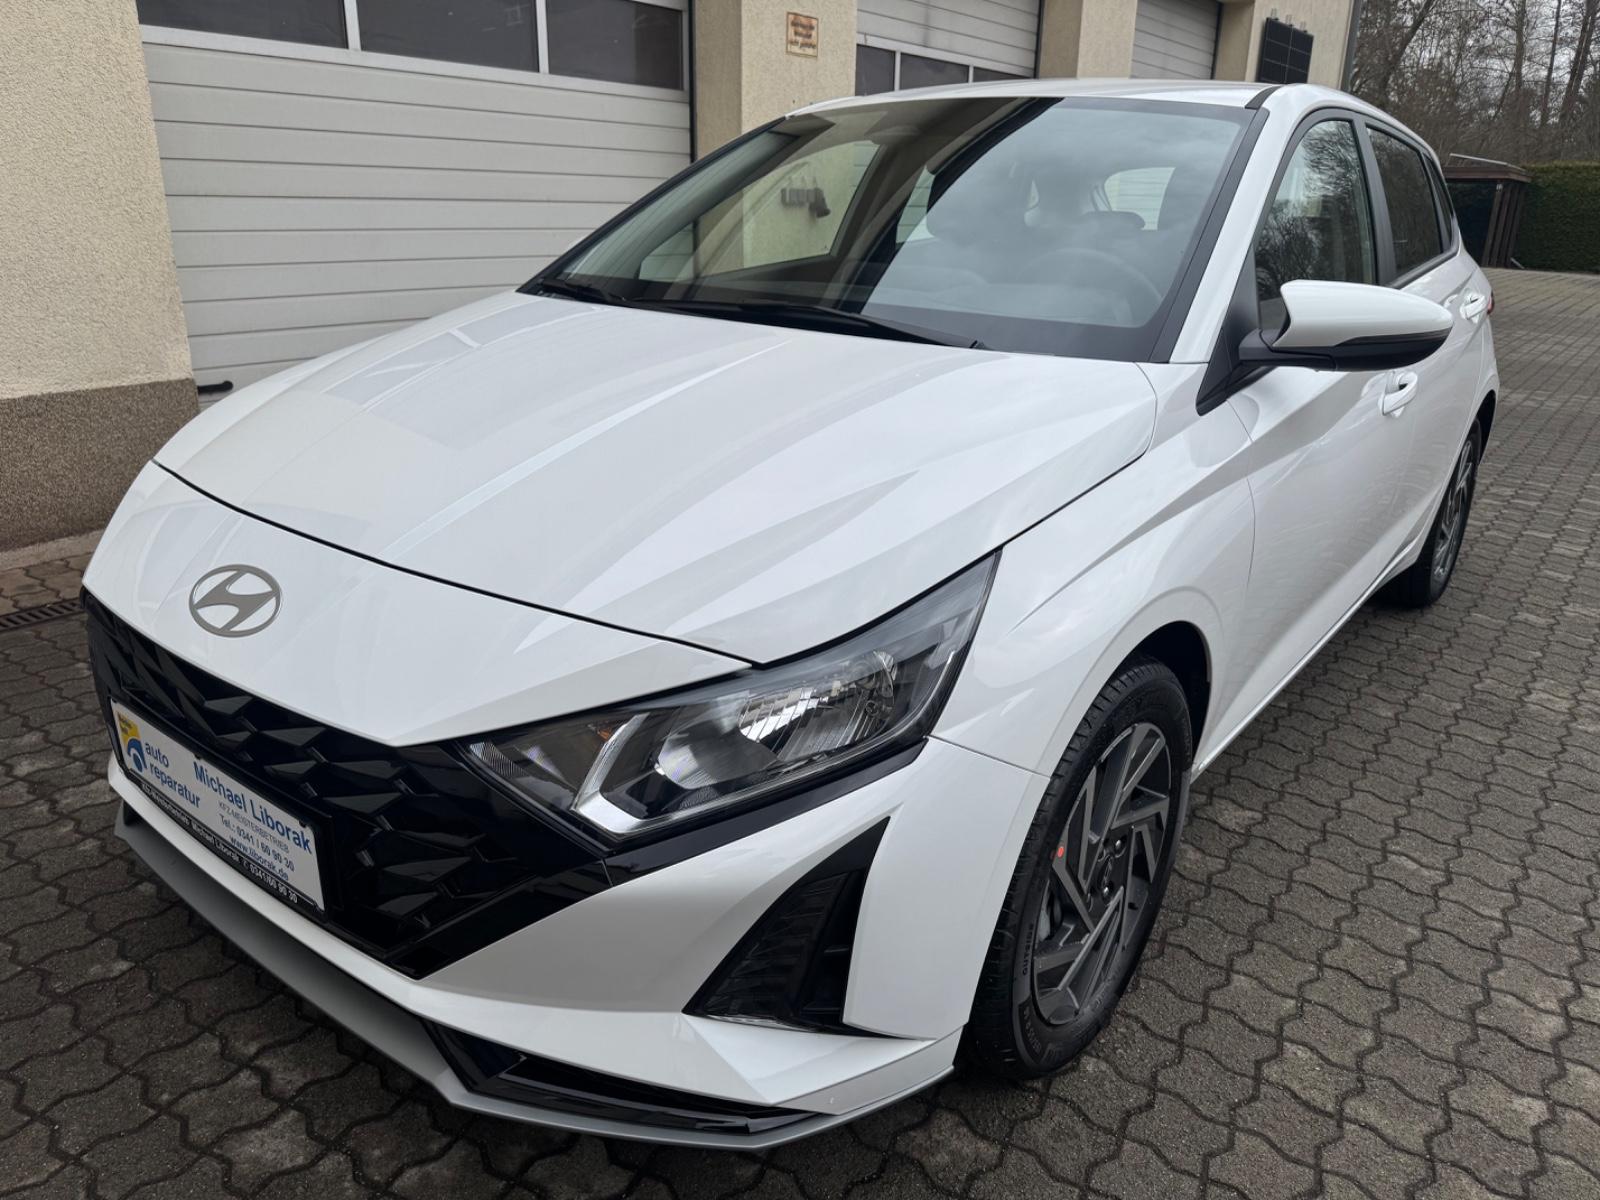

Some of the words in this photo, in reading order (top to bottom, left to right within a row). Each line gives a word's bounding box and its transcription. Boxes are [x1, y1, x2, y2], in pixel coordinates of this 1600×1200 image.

[145, 741, 169, 768] auto
[150, 764, 200, 809] reparatur
[193, 761, 246, 812] Michael
[250, 799, 311, 855] Liborak
[237, 827, 254, 846] 0341
